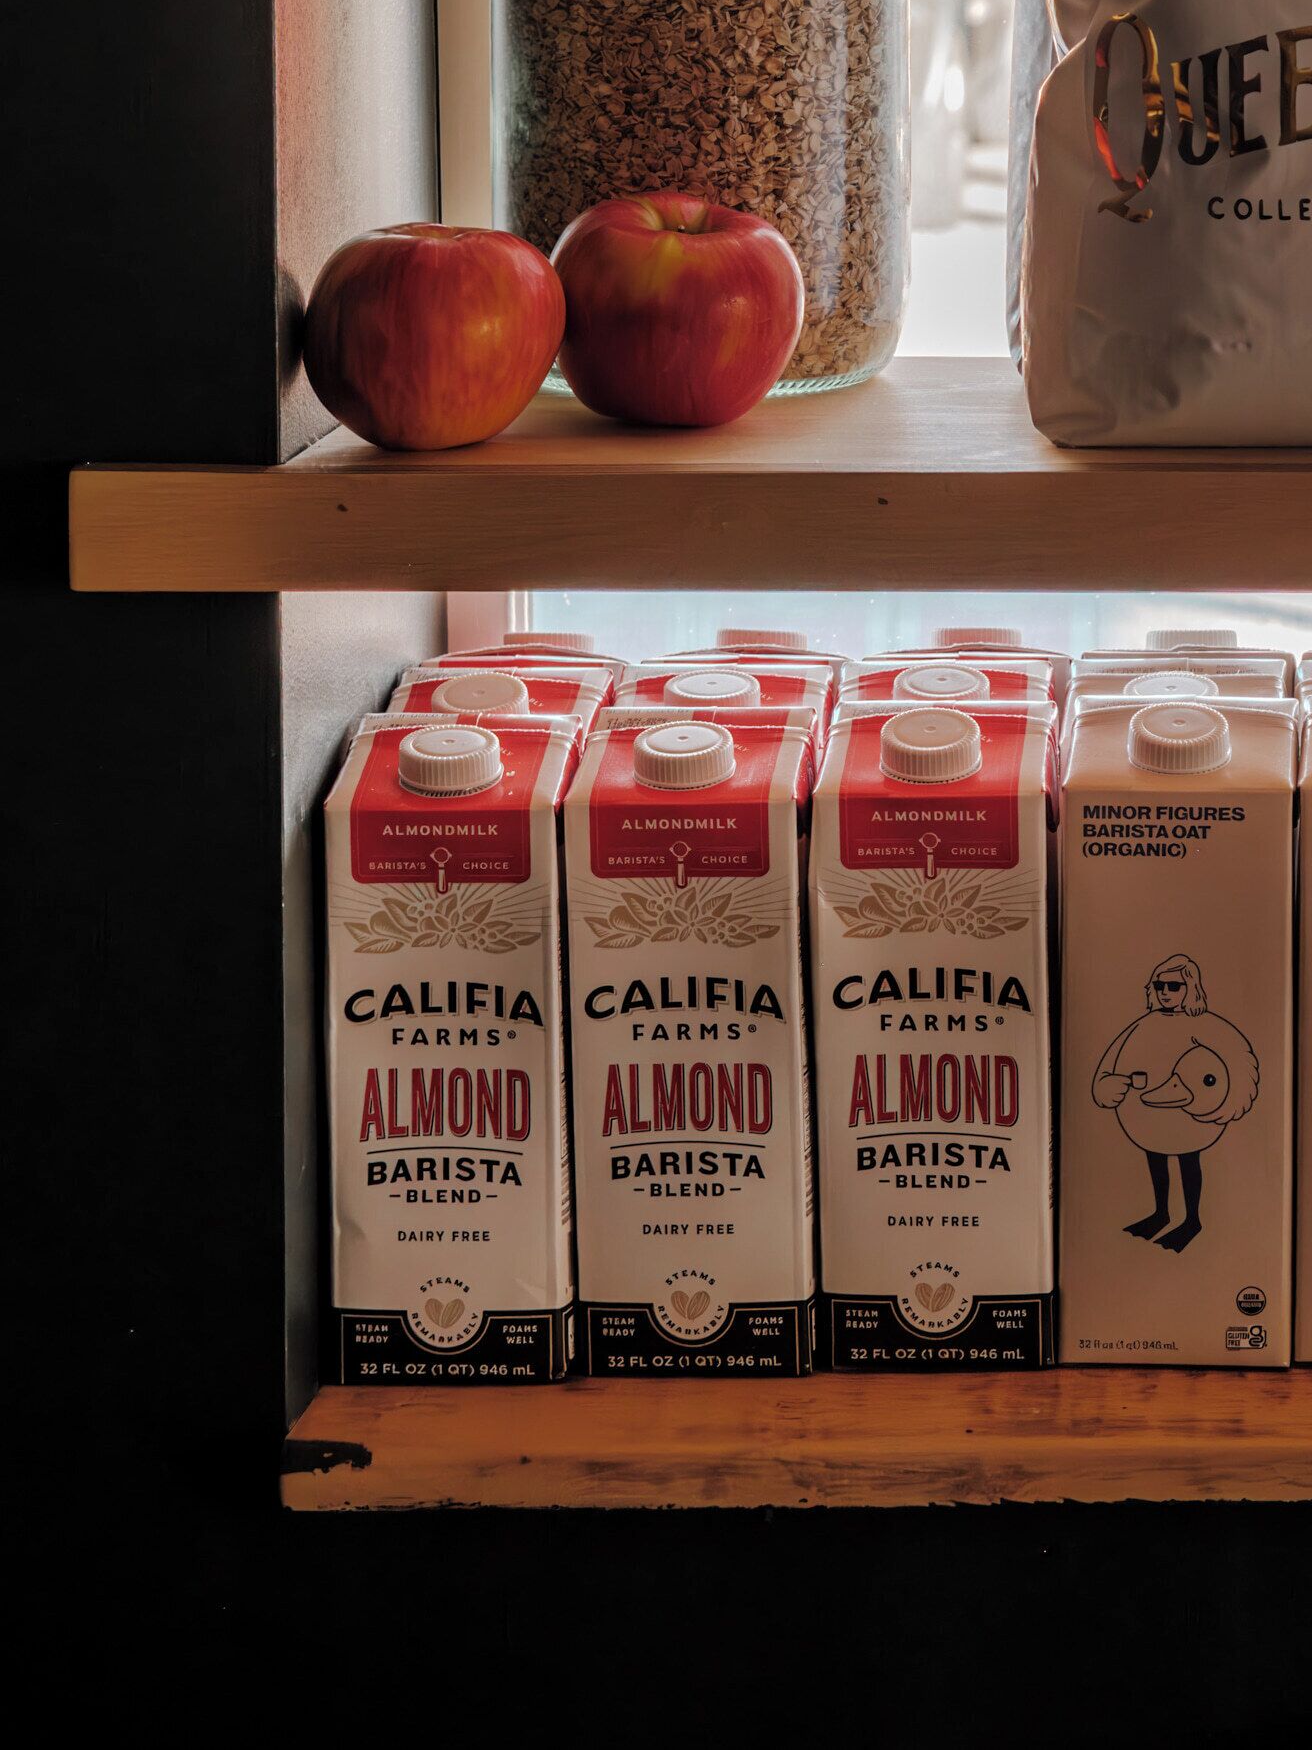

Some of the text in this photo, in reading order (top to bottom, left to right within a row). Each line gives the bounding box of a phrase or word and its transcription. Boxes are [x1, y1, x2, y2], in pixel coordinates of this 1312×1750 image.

[871, 810, 987, 822] ALMONDMILK
[1083, 805, 1245, 821] MINOR FIGURES
[382, 824, 498, 836] ALMONDMILK
[622, 818, 738, 830] ALMONDMILK
[1083, 824, 1211, 839] BARISTA OAT
[951, 847, 997, 856] CHOICE
[1082, 842, 1187, 859] (ORGANIC)
[462, 861, 510, 870] CHOICE
[701, 855, 748, 864] CHOICE
[832, 967, 1033, 1015] CALIFIA
[344, 981, 545, 1029] CALIFIA
[584, 976, 786, 1023] CALIFIA
[848, 1053, 1019, 1128] ALMOND
[359, 1067, 531, 1142] ALMOND
[602, 1062, 773, 1137] ALMOND
[857, 1142, 1011, 1171] BARISTA
[367, 1157, 522, 1186] BARISTA
[611, 1151, 766, 1180] BARISTA
[642, 1224, 735, 1235] DAIRY FREE
[887, 1216, 980, 1227] DAIRY FREE
[398, 1231, 491, 1242] DAIRY FREE
[665, 1269, 716, 1286] STEAMS
[909, 1261, 960, 1278] STEAMS
[419, 1276, 471, 1294] STEAMS
[608, 1355, 625, 1367] 32
[630, 1355, 647, 1367] FL
[652, 1355, 674, 1367] OZ
[726, 1355, 755, 1366] 946
[759, 1355, 782, 1367] mL
[850, 1348, 868, 1360] 32
[873, 1348, 891, 1360] FL
[895, 1348, 916, 1360] OZ
[970, 1348, 998, 1360] 946
[1003, 1348, 1025, 1360] mL
[360, 1363, 378, 1375] 32
[383, 1363, 400, 1374] FL
[405, 1363, 426, 1375] OZ
[479, 1363, 508, 1375] 946
[513, 1364, 535, 1376] mL
